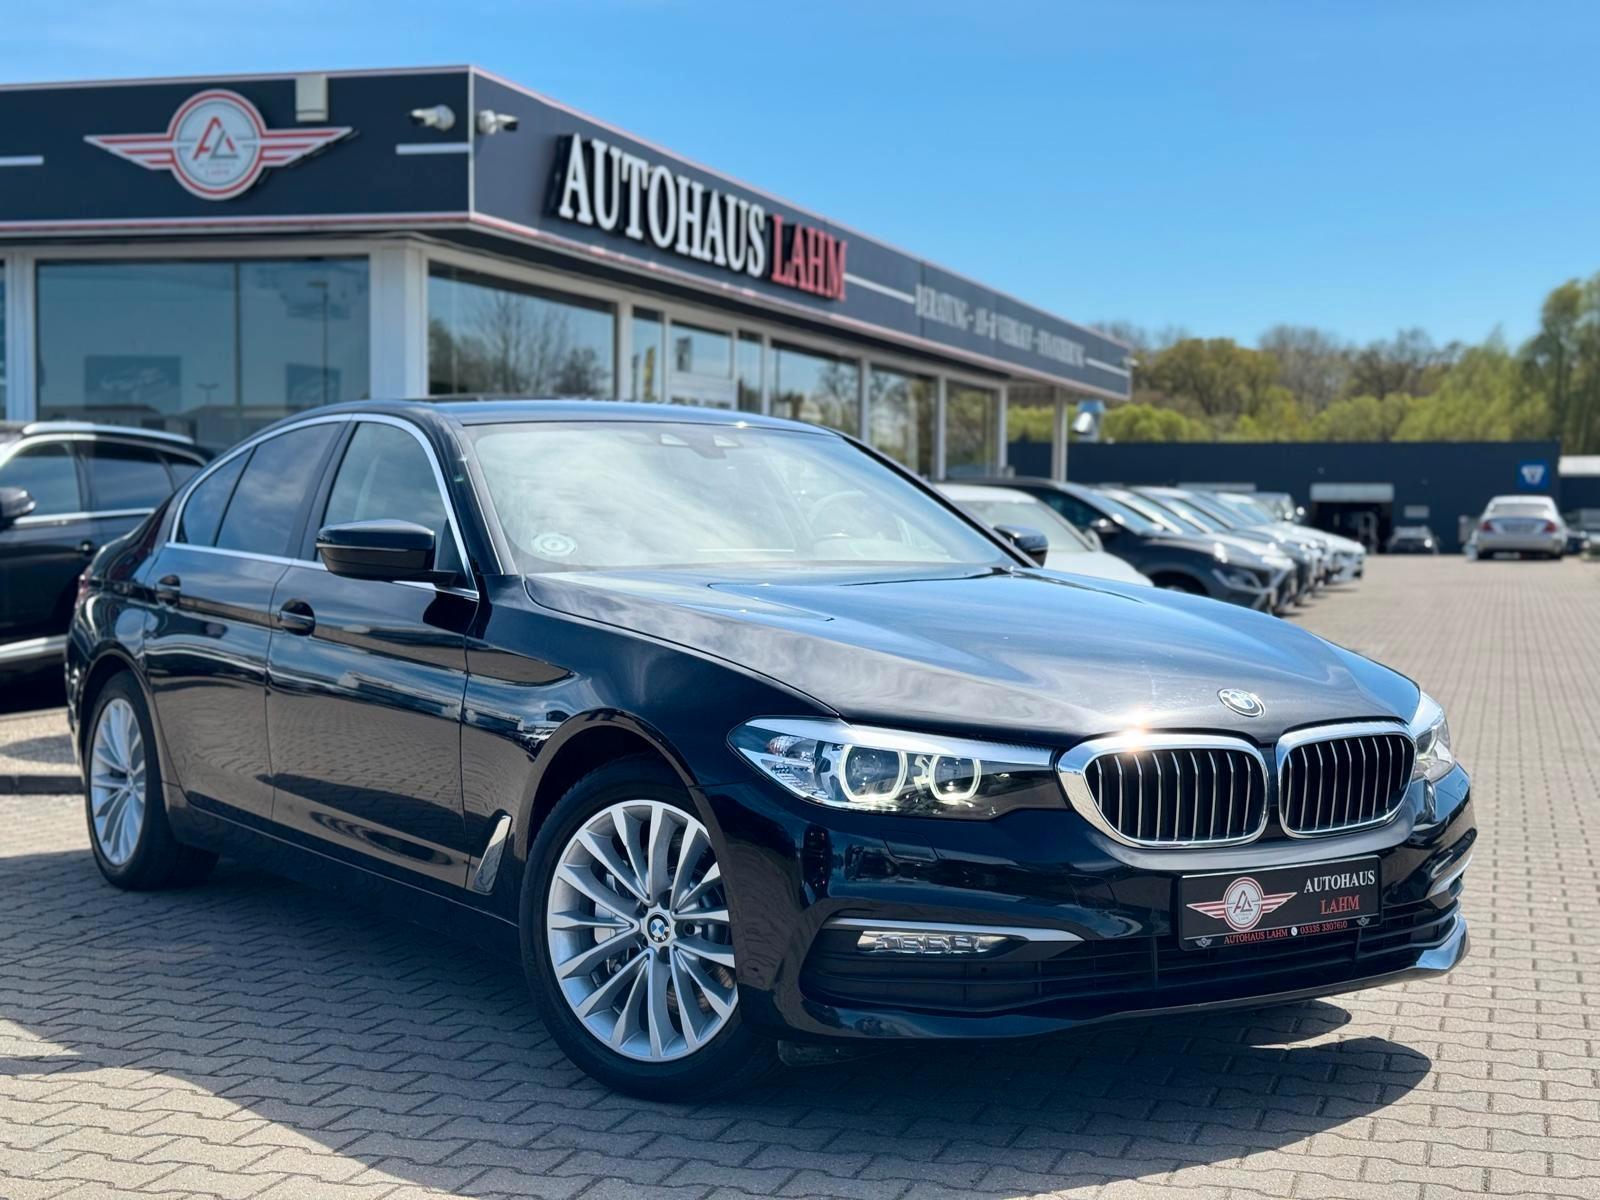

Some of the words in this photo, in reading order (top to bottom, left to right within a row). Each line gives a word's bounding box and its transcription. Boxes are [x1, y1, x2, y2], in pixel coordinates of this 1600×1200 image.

[558, 133, 765, 277] AUTOHAUS
[771, 214, 848, 303] LAHM
[1303, 870, 1376, 894] AUTOHAUS
[1320, 895, 1360, 914] LAHM
[1223, 932, 1265, 944] AUTOHAUS
[1266, 927, 1288, 939] LAHM
